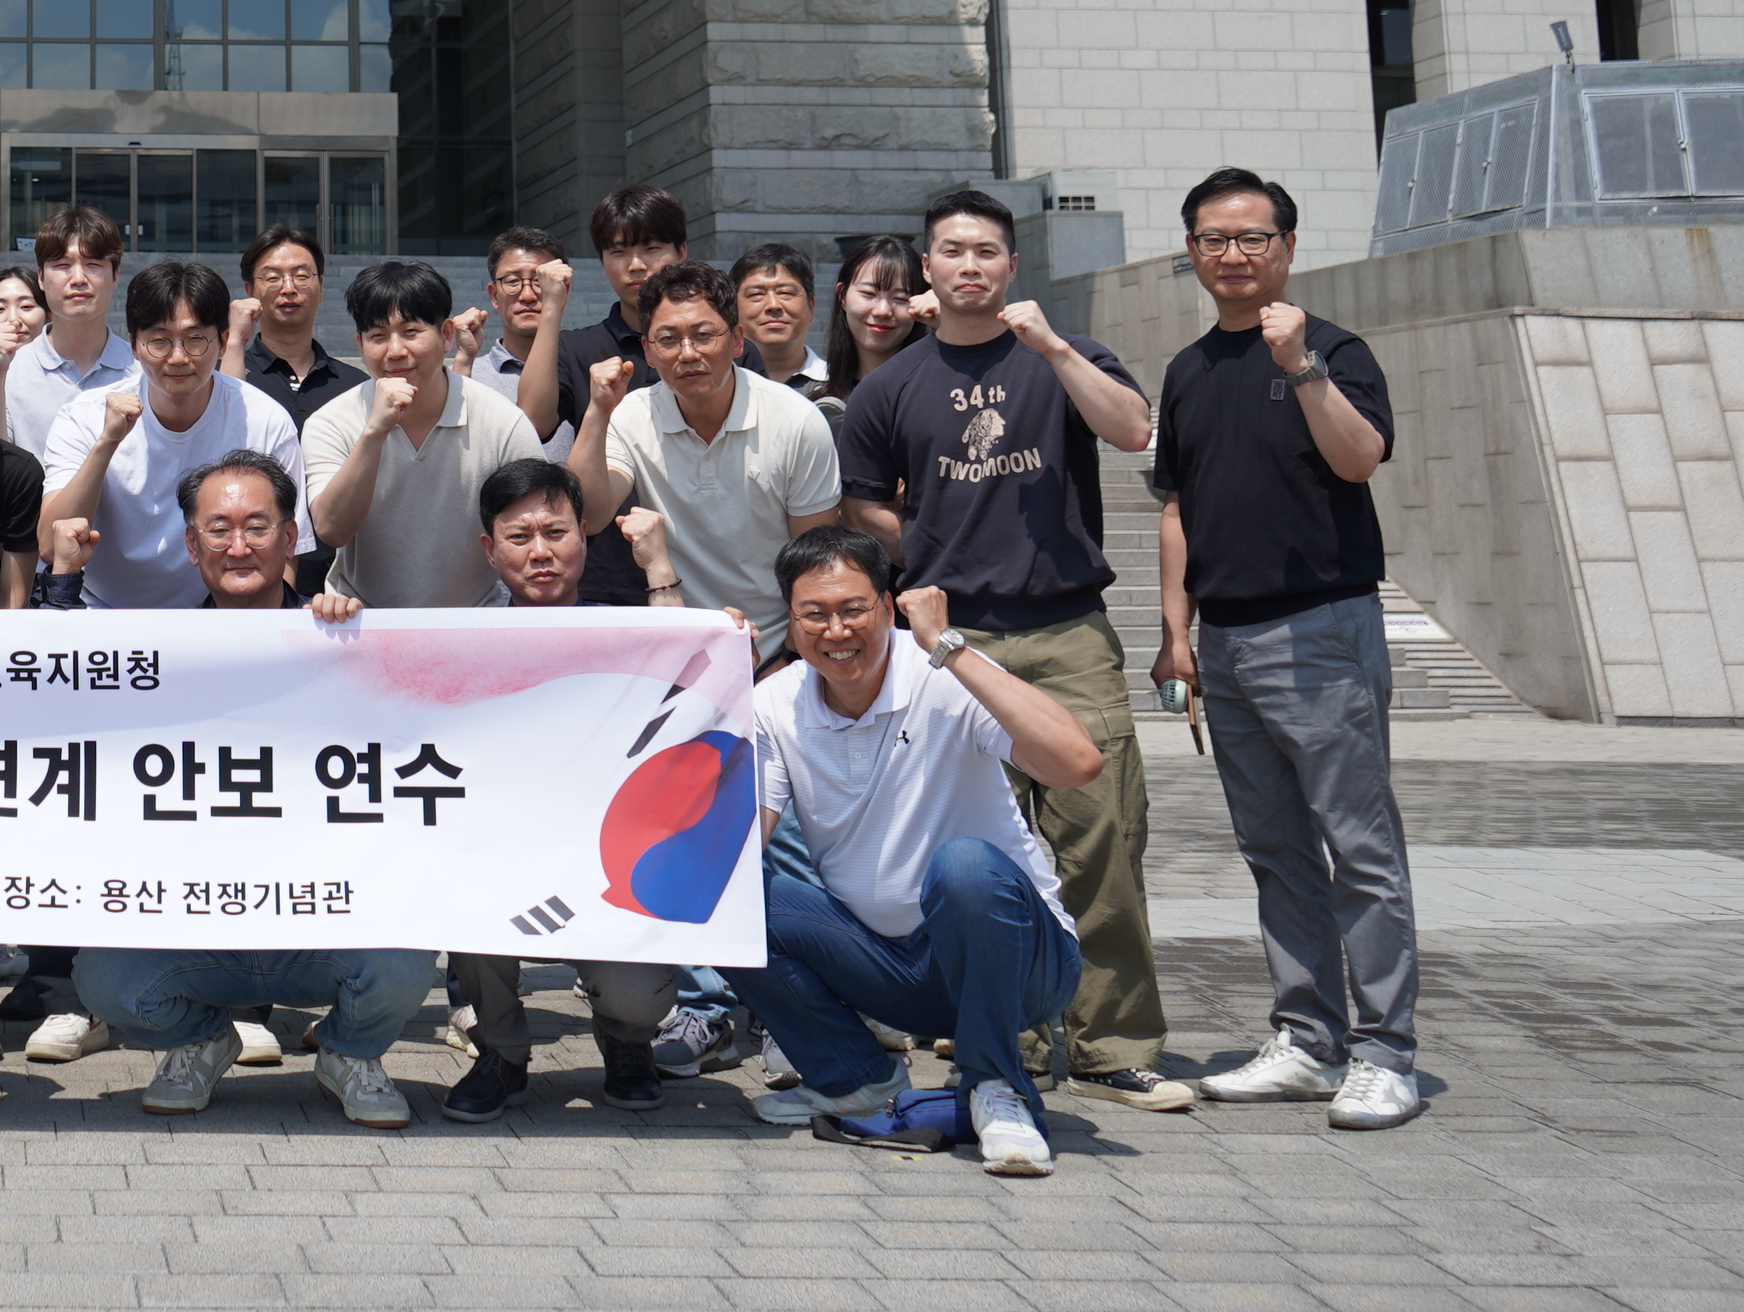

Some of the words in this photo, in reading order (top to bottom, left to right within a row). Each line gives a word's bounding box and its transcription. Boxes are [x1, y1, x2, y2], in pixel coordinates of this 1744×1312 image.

[938, 447, 1042, 483] TWOMOON
[132, 741, 284, 821] 안보
[314, 742, 466, 826] 연수
[3, 875, 82, 911] 장소:
[99, 879, 167, 914] 용산
[182, 881, 355, 916] 전쟁기념관
